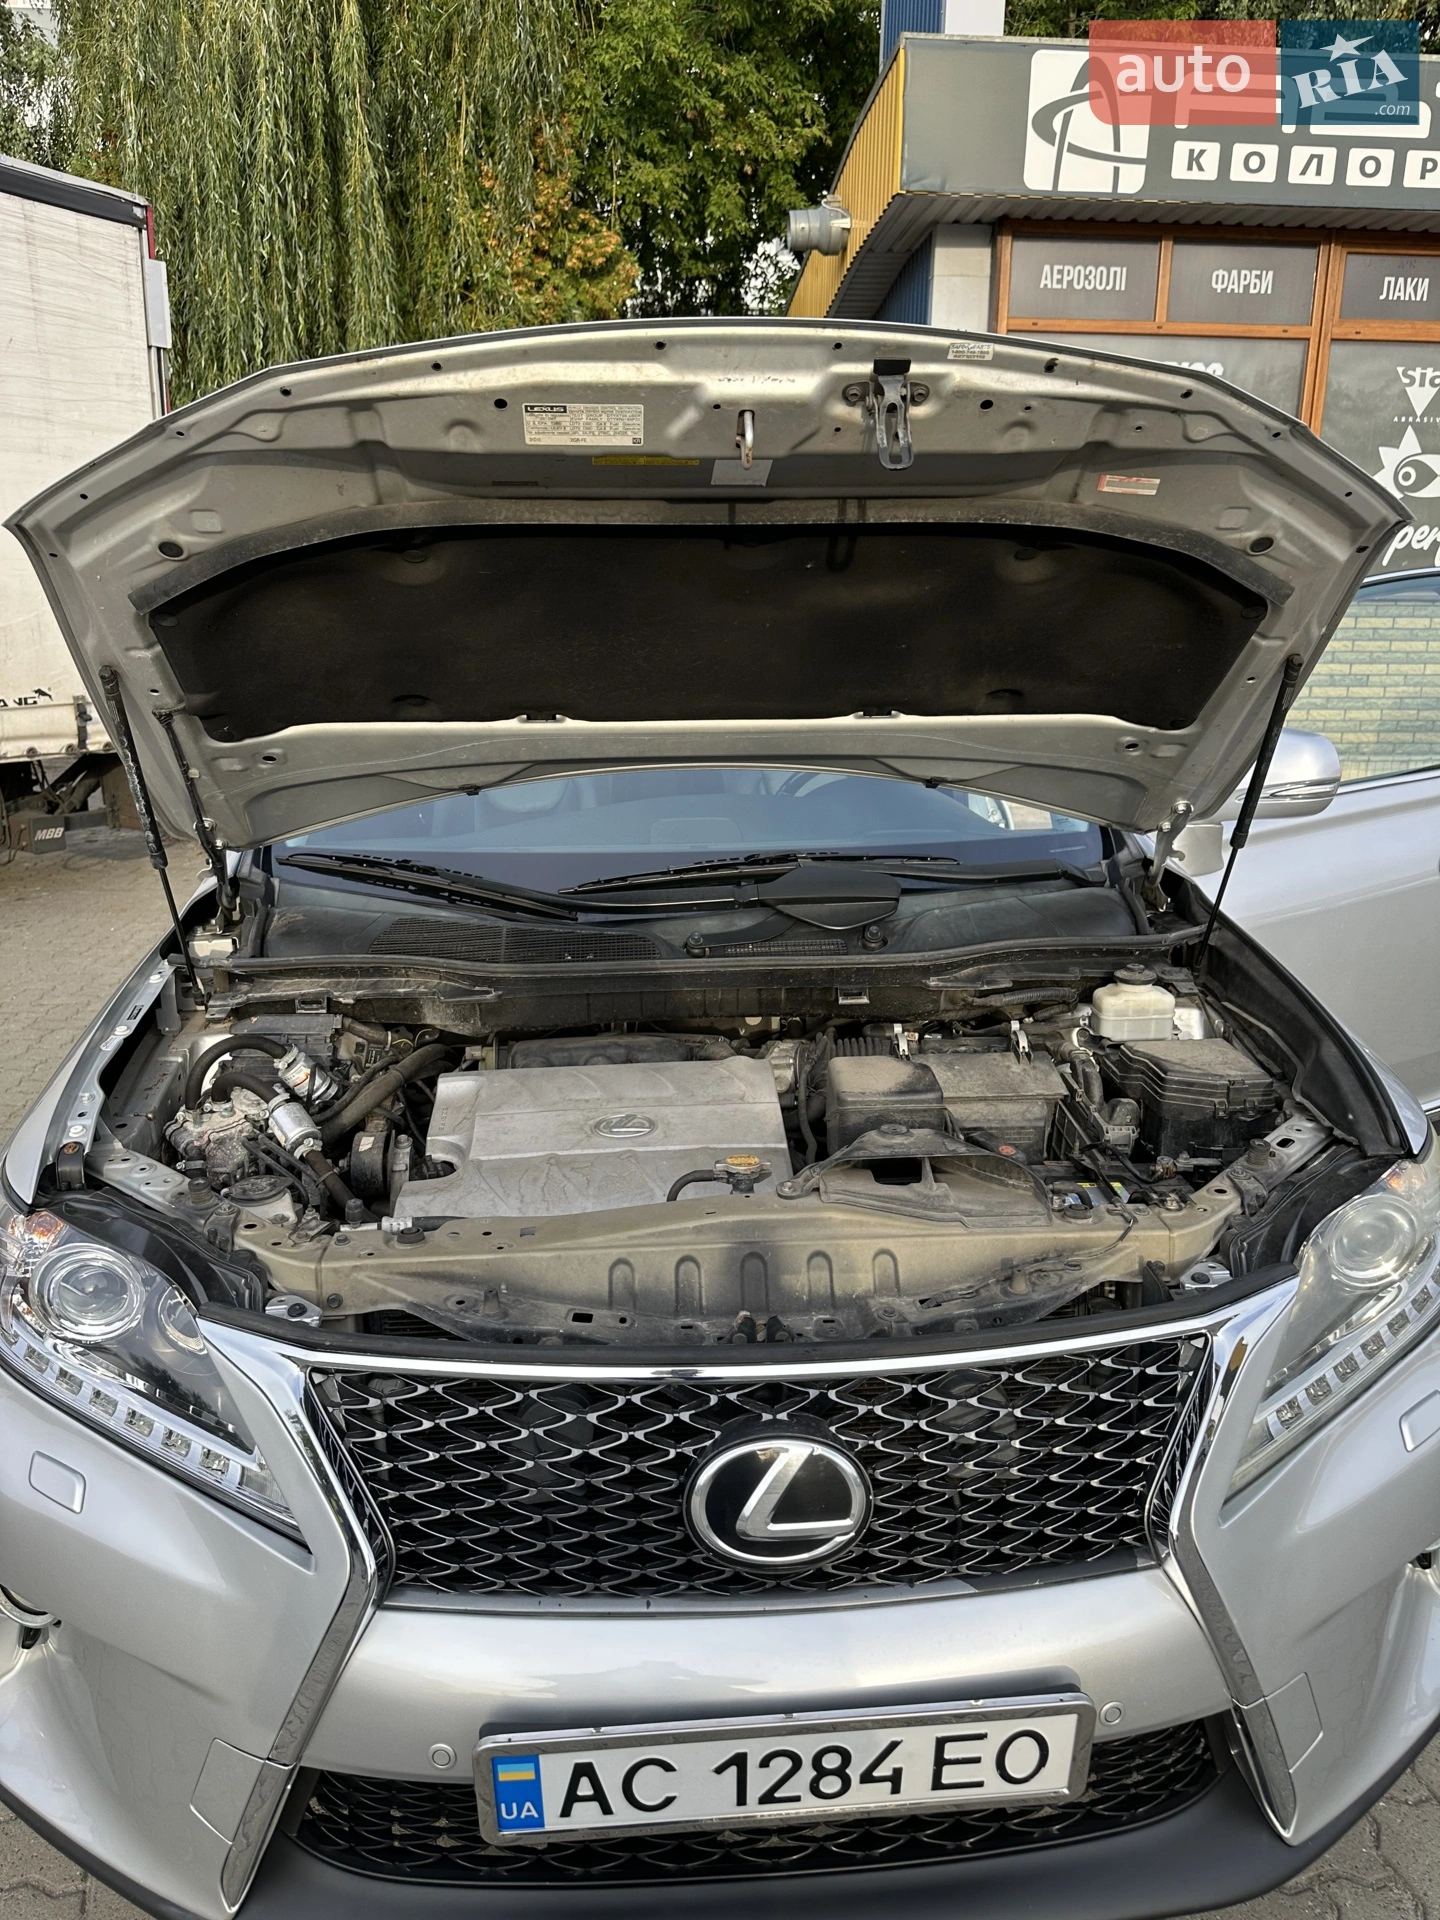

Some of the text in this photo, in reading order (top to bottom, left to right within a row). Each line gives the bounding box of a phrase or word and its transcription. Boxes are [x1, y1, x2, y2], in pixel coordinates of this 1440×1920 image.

[1186, 148, 1438, 181] КОЛОР
[1040, 264, 1127, 291] АЕРОЗОЛІ
[1211, 268, 1274, 295] ФАРБИ
[1379, 276, 1430, 302] ЛАКИ
[34, 827, 64, 841] MBB
[559, 1728, 1050, 1818] AC 1284 EO
[501, 1801, 540, 1821] UA
